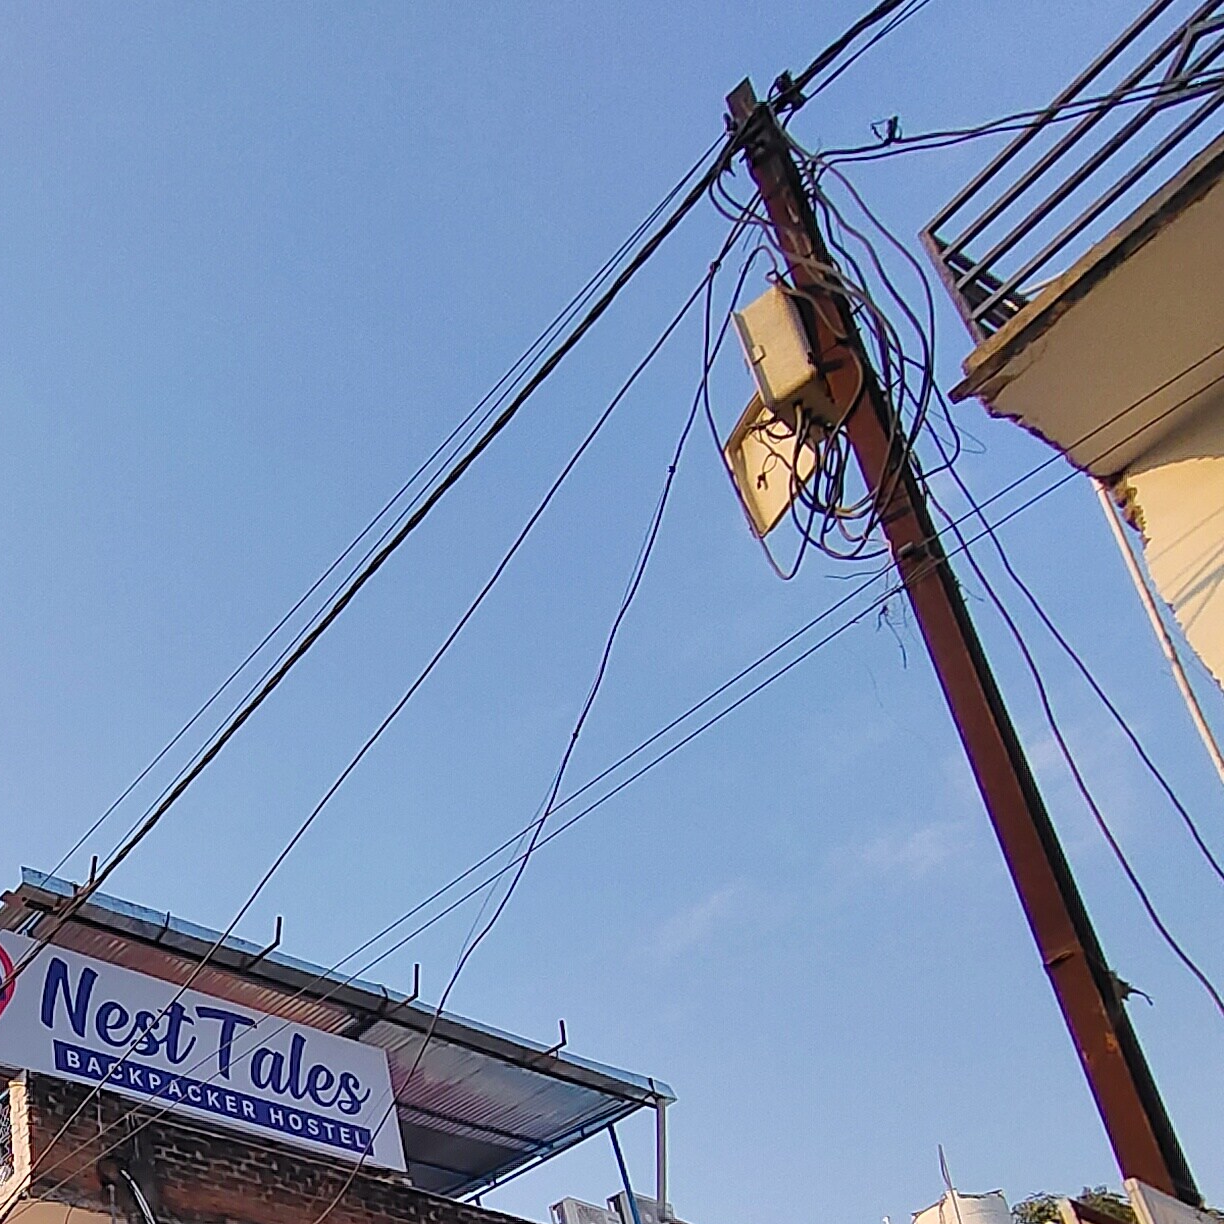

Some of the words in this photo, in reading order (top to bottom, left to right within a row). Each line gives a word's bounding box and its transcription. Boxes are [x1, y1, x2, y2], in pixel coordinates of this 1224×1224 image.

[40, 956, 197, 1065] Nest
[195, 1005, 371, 1115] Tales
[66, 1049, 257, 1119] BACKPACKER
[269, 1107, 368, 1149] HOSTEL
